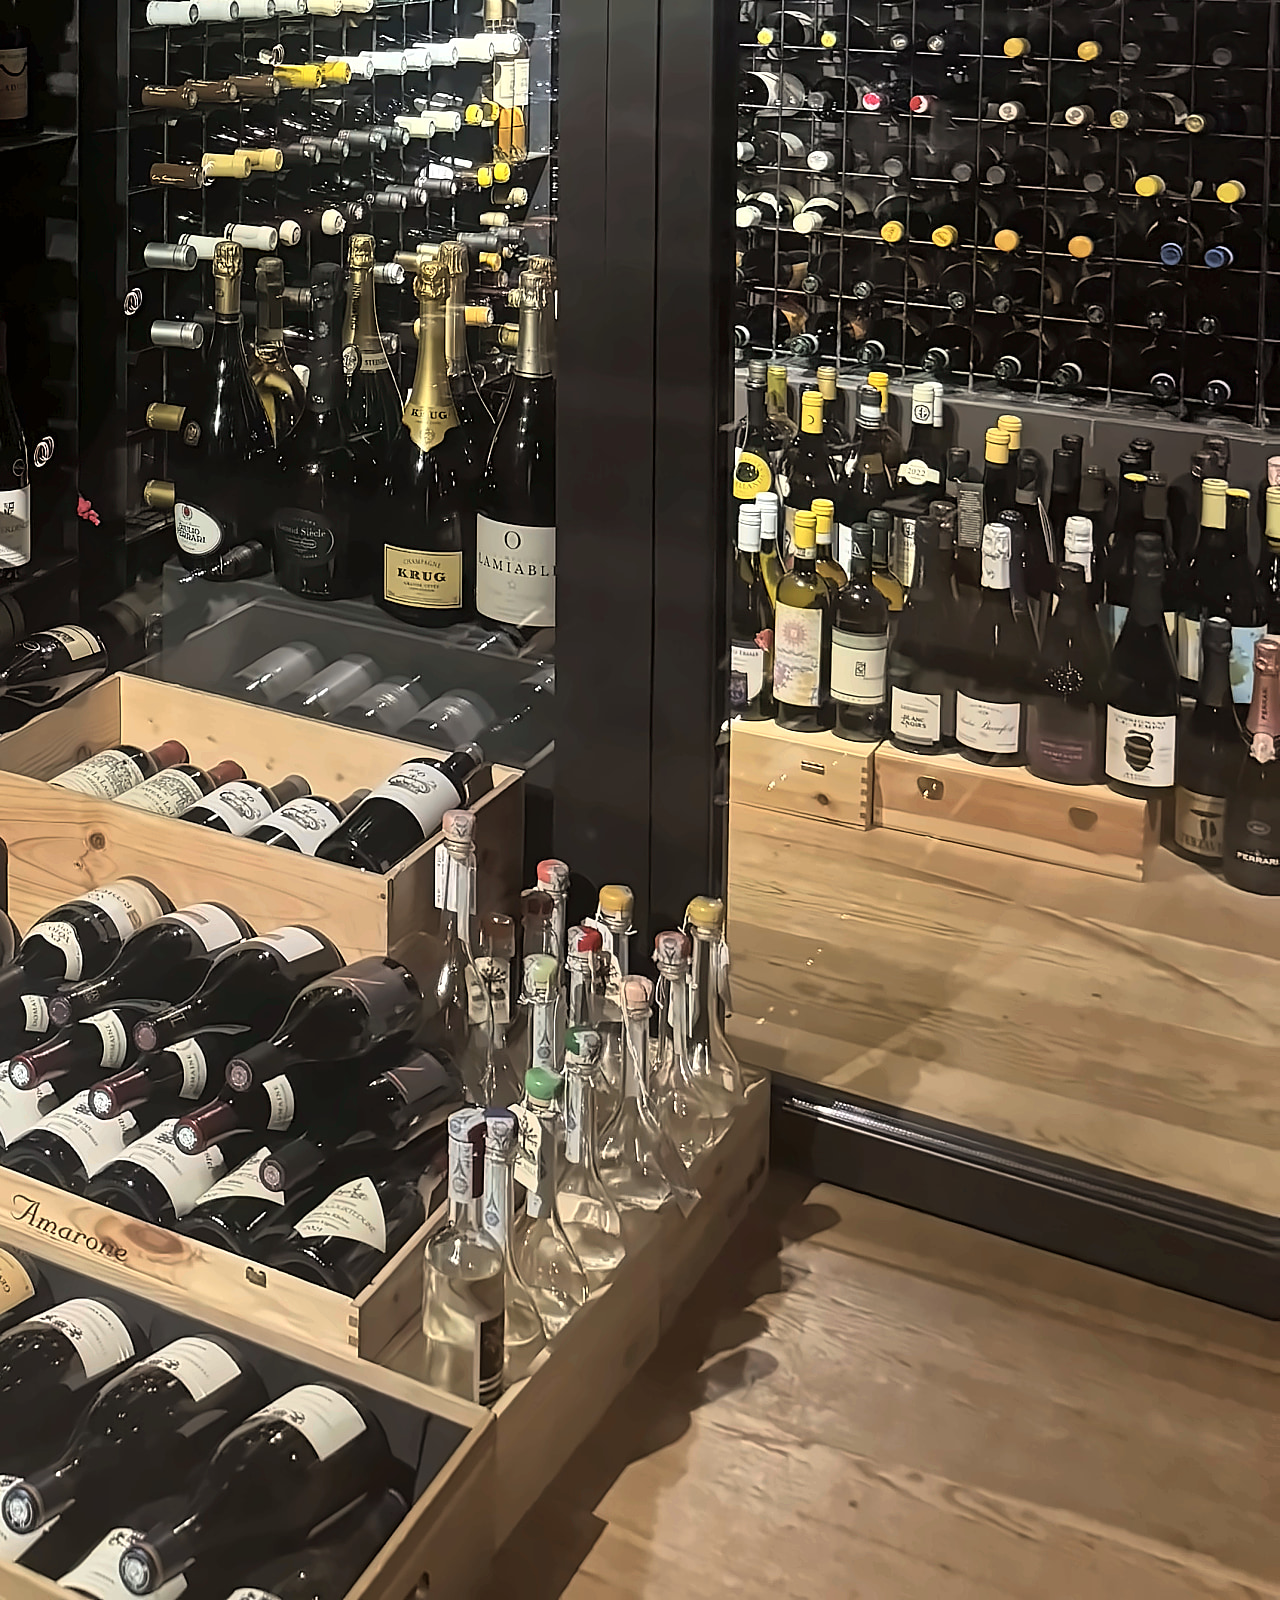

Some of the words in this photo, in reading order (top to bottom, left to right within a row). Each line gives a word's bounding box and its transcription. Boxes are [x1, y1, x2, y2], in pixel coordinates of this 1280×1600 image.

[397, 567, 447, 582] KRUG
[1236, 850, 1280, 867] FERRARI
[10, 1194, 128, 1263] Amarone
